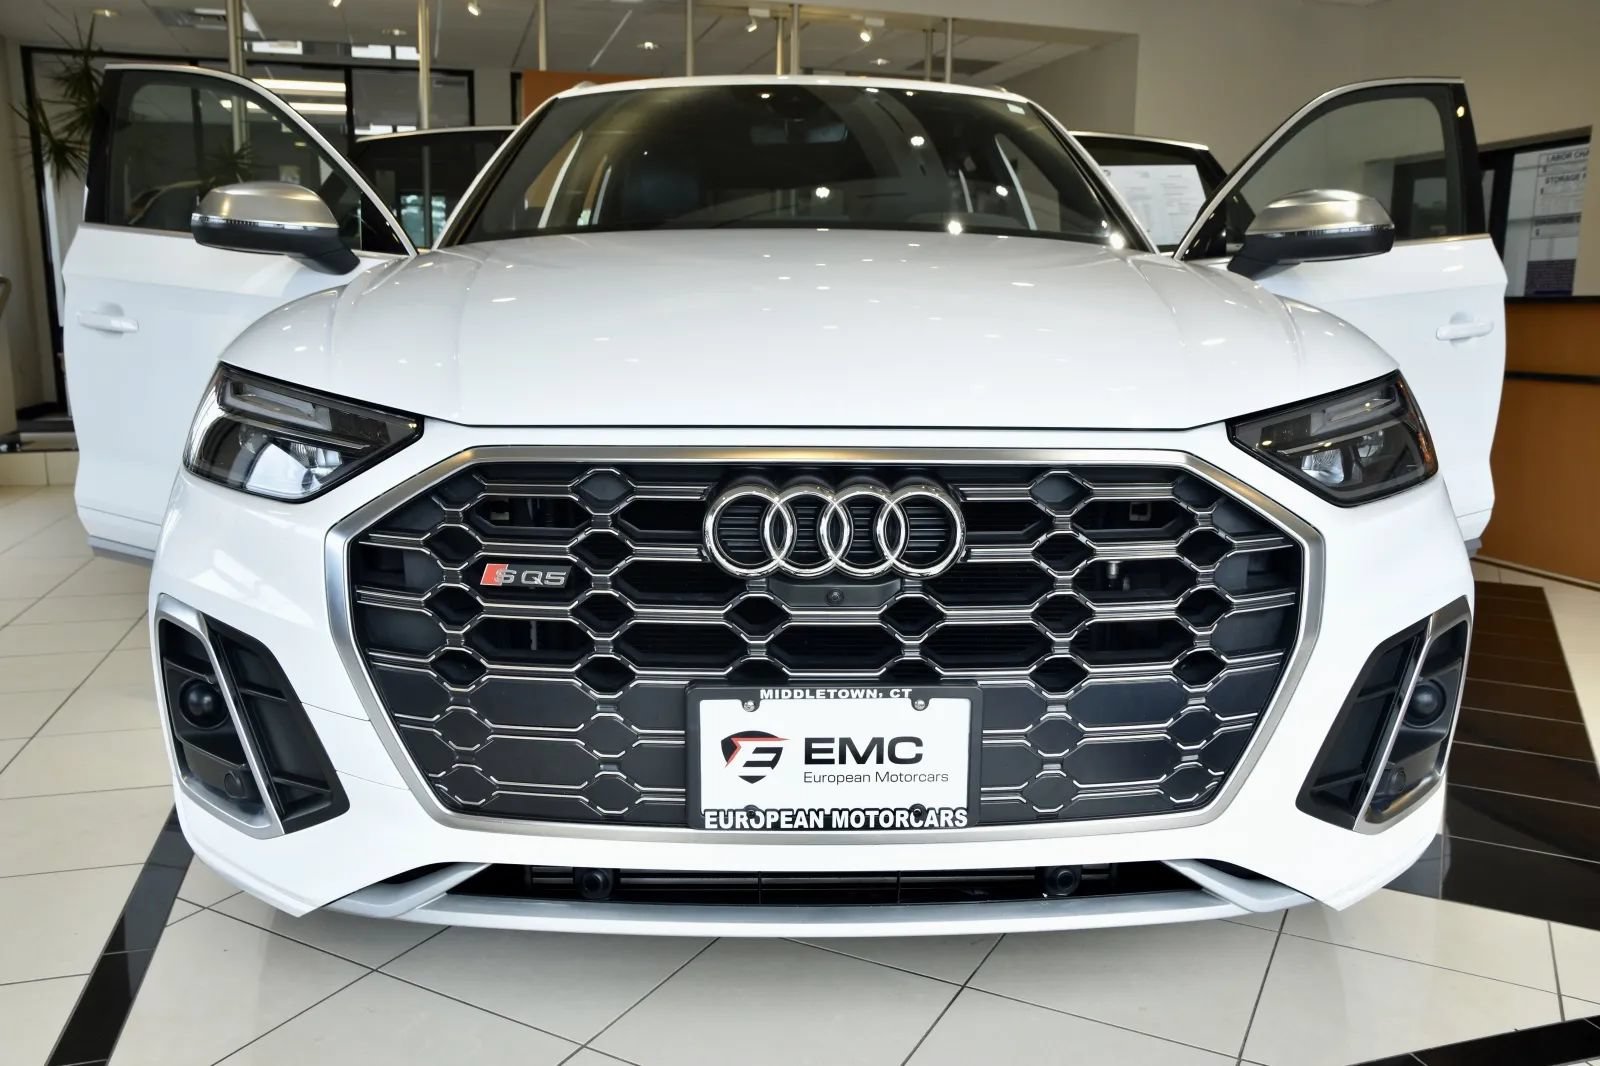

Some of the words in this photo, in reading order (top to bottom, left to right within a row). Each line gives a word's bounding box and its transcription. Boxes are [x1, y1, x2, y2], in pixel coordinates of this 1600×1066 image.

[1545, 173, 1580, 184] STORAGE
[760, 688, 883, 700] MIDDLETOWN,
[889, 688, 913, 698] CT
[804, 736, 924, 765] EMC
[803, 771, 871, 786] European
[875, 771, 949, 783] Motorcars
[704, 809, 824, 829] EUROPEAN
[831, 808, 968, 829] MOTORCARS
